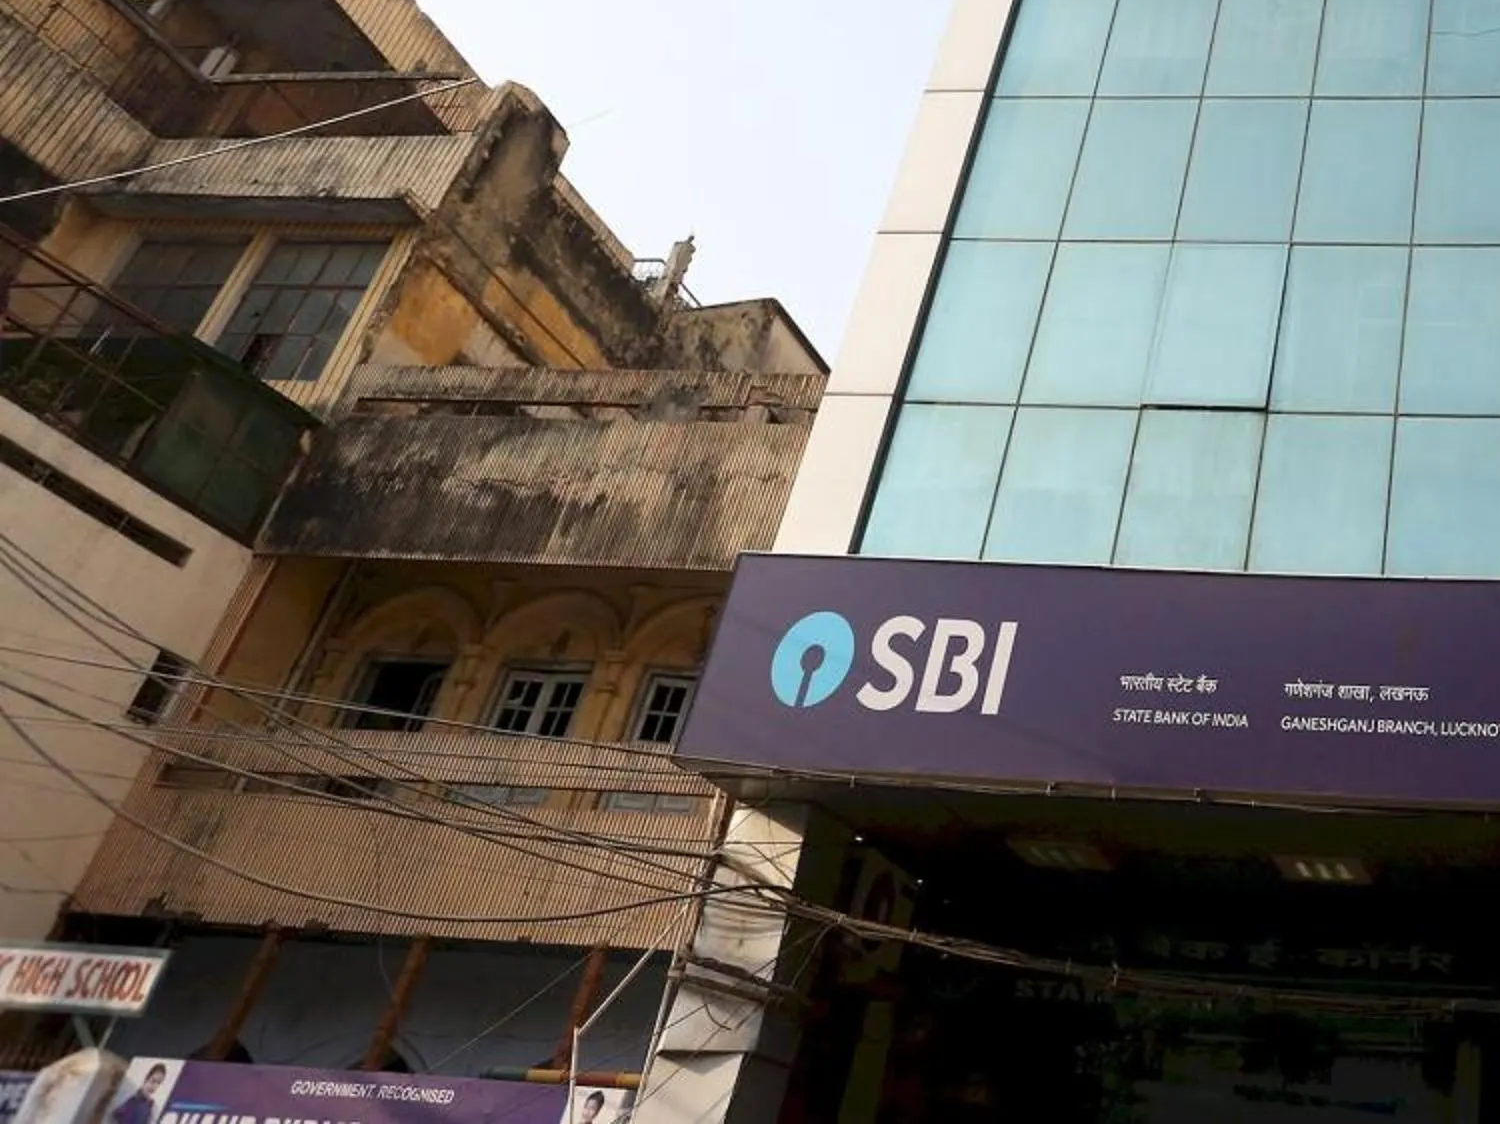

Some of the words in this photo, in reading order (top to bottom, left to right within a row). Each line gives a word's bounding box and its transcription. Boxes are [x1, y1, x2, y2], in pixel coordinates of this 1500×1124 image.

[856, 615, 1019, 715] SBI
[1120, 672, 1164, 692] भारतीय
[1167, 673, 1194, 694] स्टेट
[1284, 677, 1334, 700] गणेशगंज
[1337, 684, 1375, 703] शाखा,
[1379, 685, 1430, 702] लखनऊ
[1112, 708, 1153, 724] STATE
[1153, 710, 1191, 726] BANK
[1191, 711, 1212, 727] OF
[1211, 712, 1249, 728] INDIA
[1280, 715, 1376, 733] GANESHGANJ
[1377, 719, 1438, 737] BRANCH,
[8, 955, 71, 997] HIGH
[65, 958, 152, 1003] SCHOOL
[290, 1079, 377, 1099] GOVERNMENT
[377, 1084, 455, 1105] RECOGNISED
